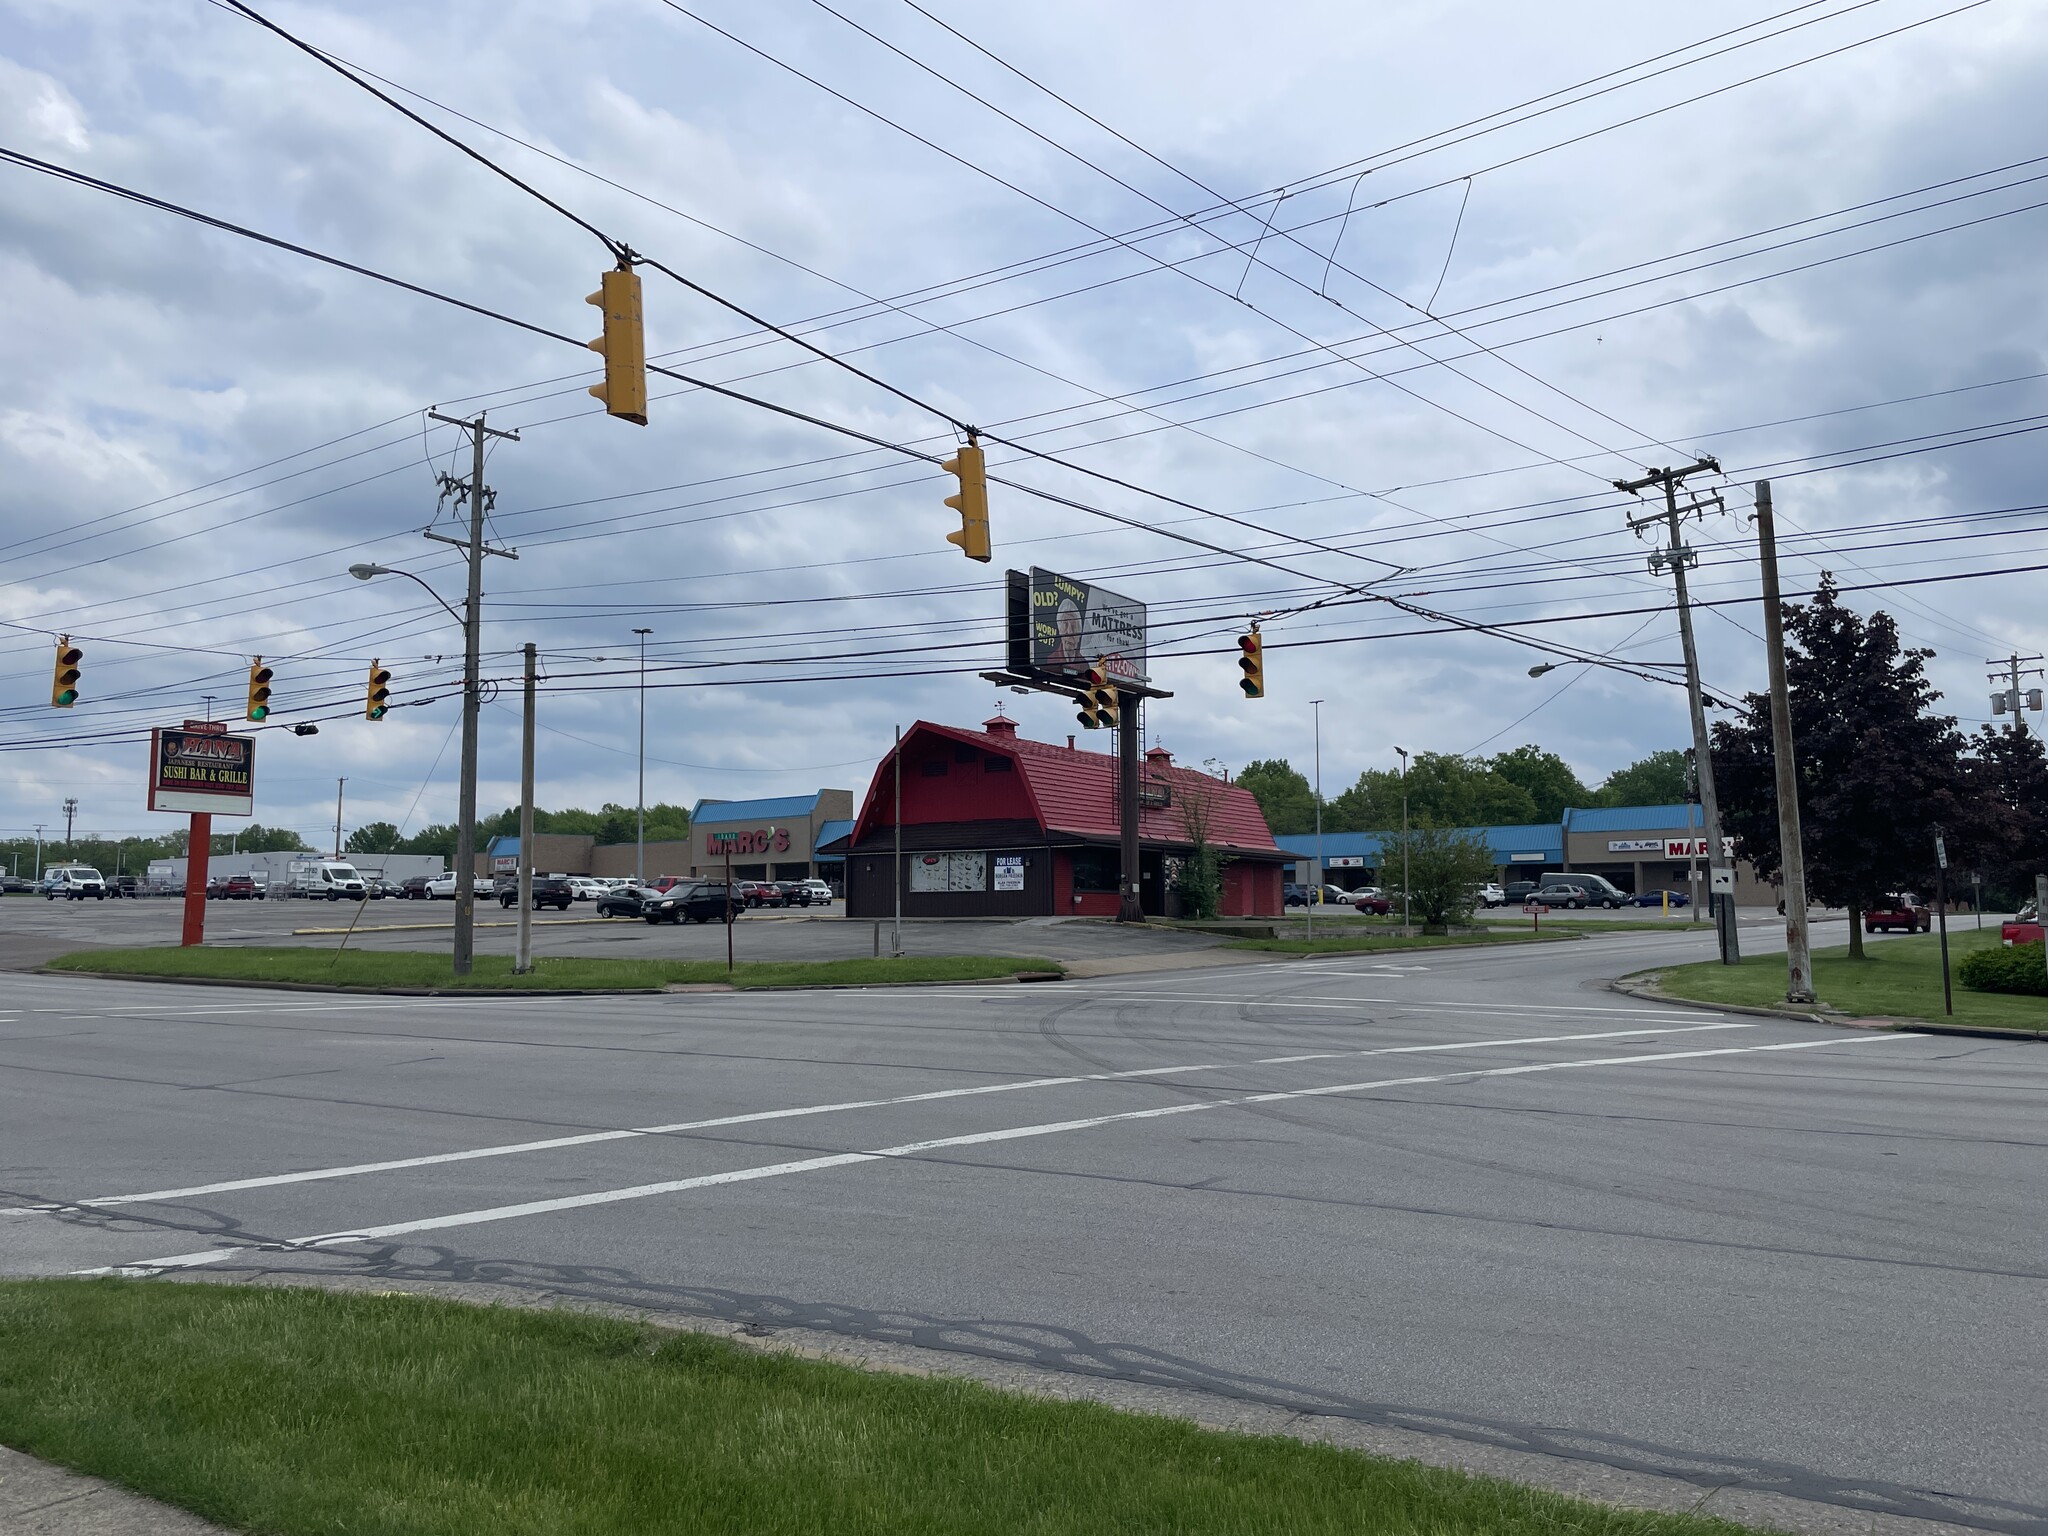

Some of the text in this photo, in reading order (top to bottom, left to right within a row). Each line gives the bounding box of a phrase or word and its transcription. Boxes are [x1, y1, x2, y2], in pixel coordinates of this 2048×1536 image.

[1054, 576, 1085, 603] LUMPY?
[1033, 592, 1058, 606] OLD?
[1035, 621, 1056, 636] WORN
[1092, 612, 1142, 640] MATTRESS
[190, 722, 224, 732] DRIVE-THRU
[181, 737, 241, 760] HANA
[168, 758, 234, 770] JAPANESE RESTAURANT
[163, 766, 247, 784] SUSHI BAR & GRILLE
[706, 826, 789, 855] MARC'S
[1007, 857, 1021, 865] LEASE
